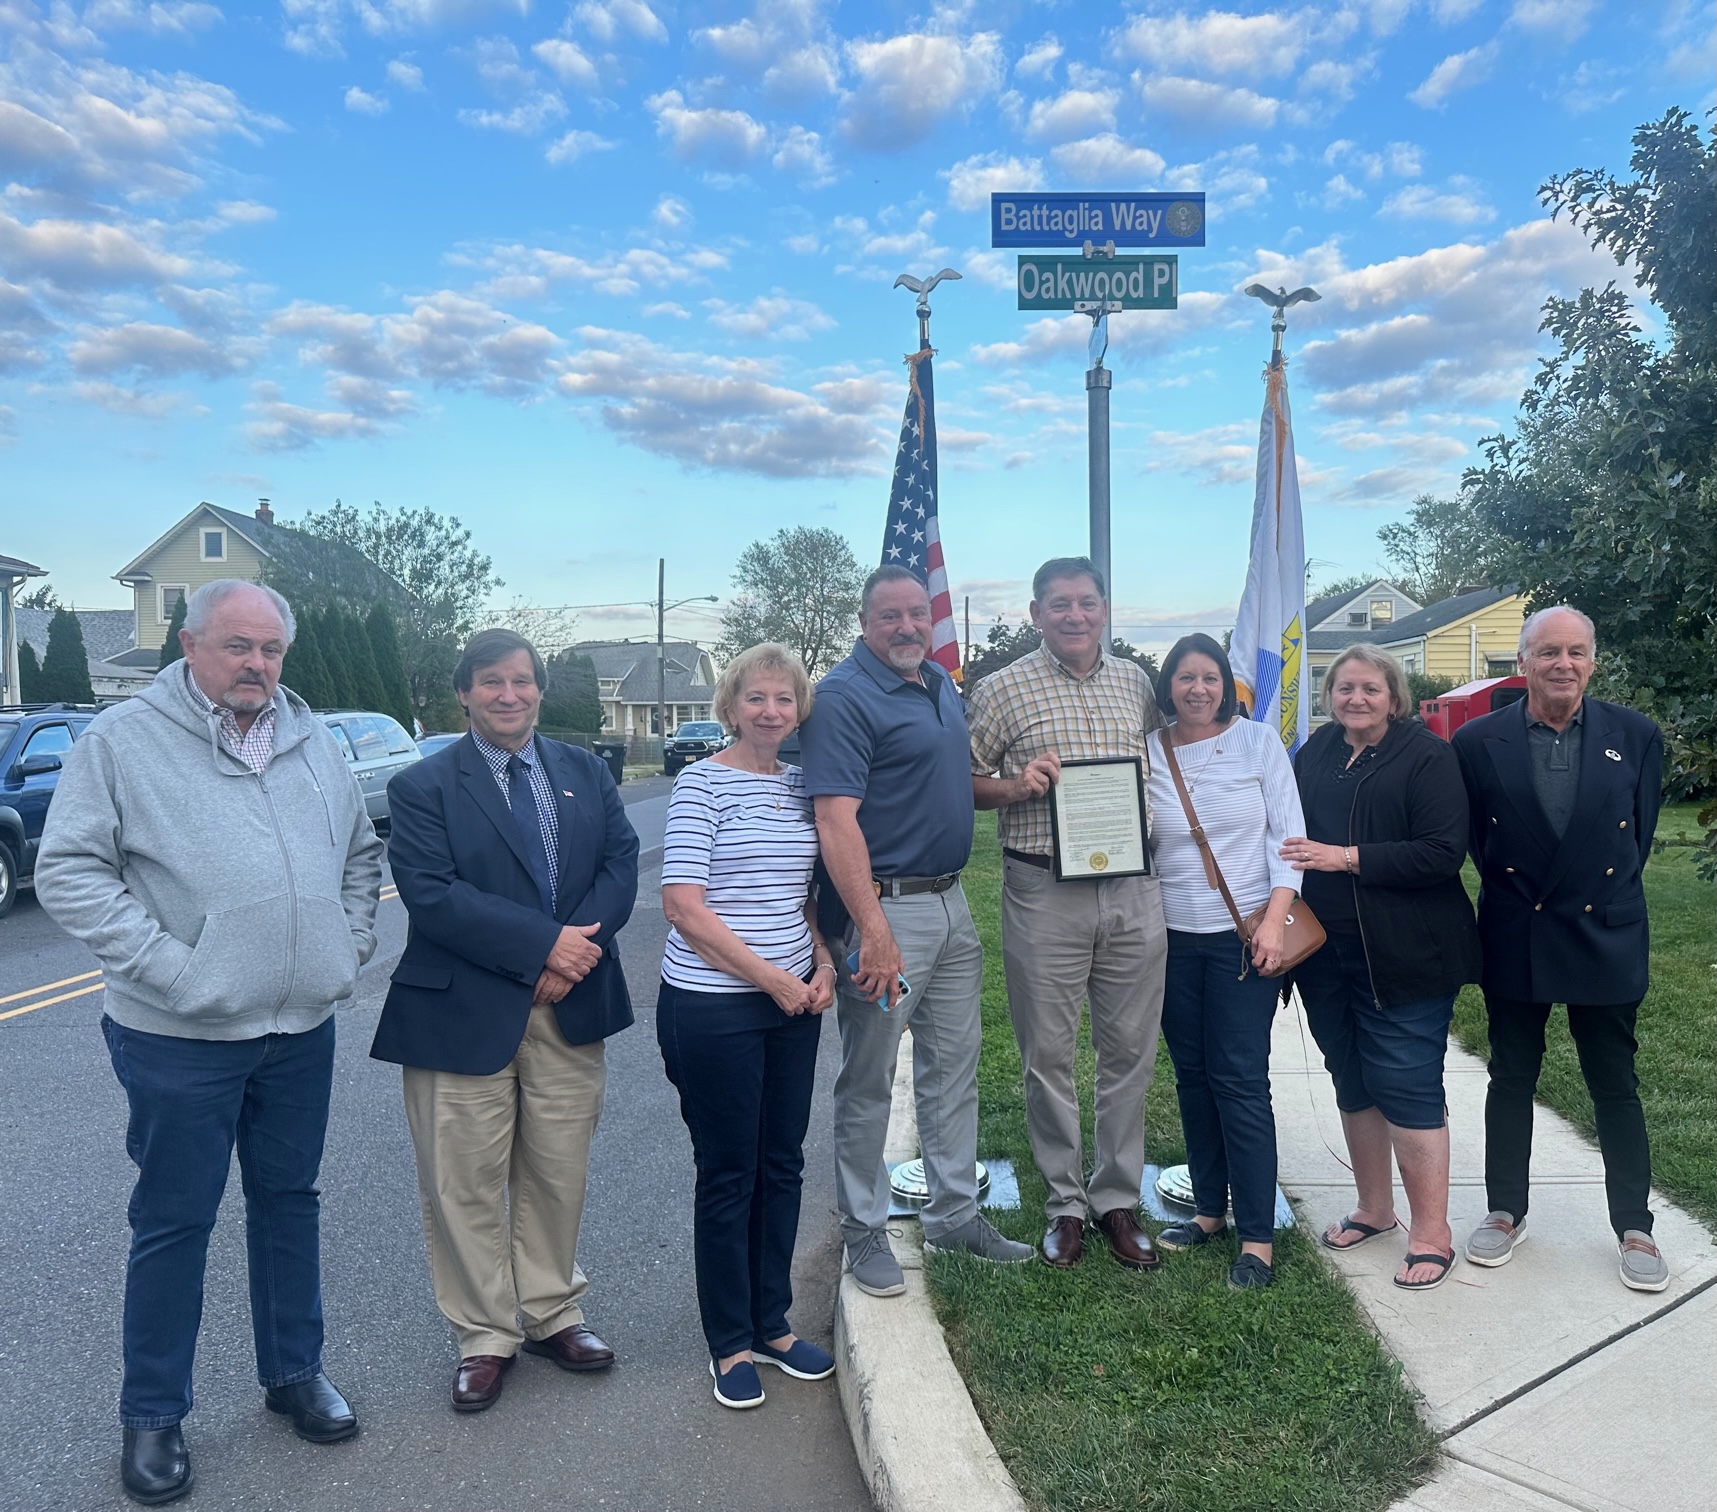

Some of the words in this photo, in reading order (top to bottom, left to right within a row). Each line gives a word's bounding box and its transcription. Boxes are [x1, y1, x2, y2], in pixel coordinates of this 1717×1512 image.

[1000, 202, 1103, 238] Battaglia
[1110, 202, 1162, 238] Way
[1019, 262, 1144, 299] Oakwood
[1153, 262, 1177, 298] Pl
